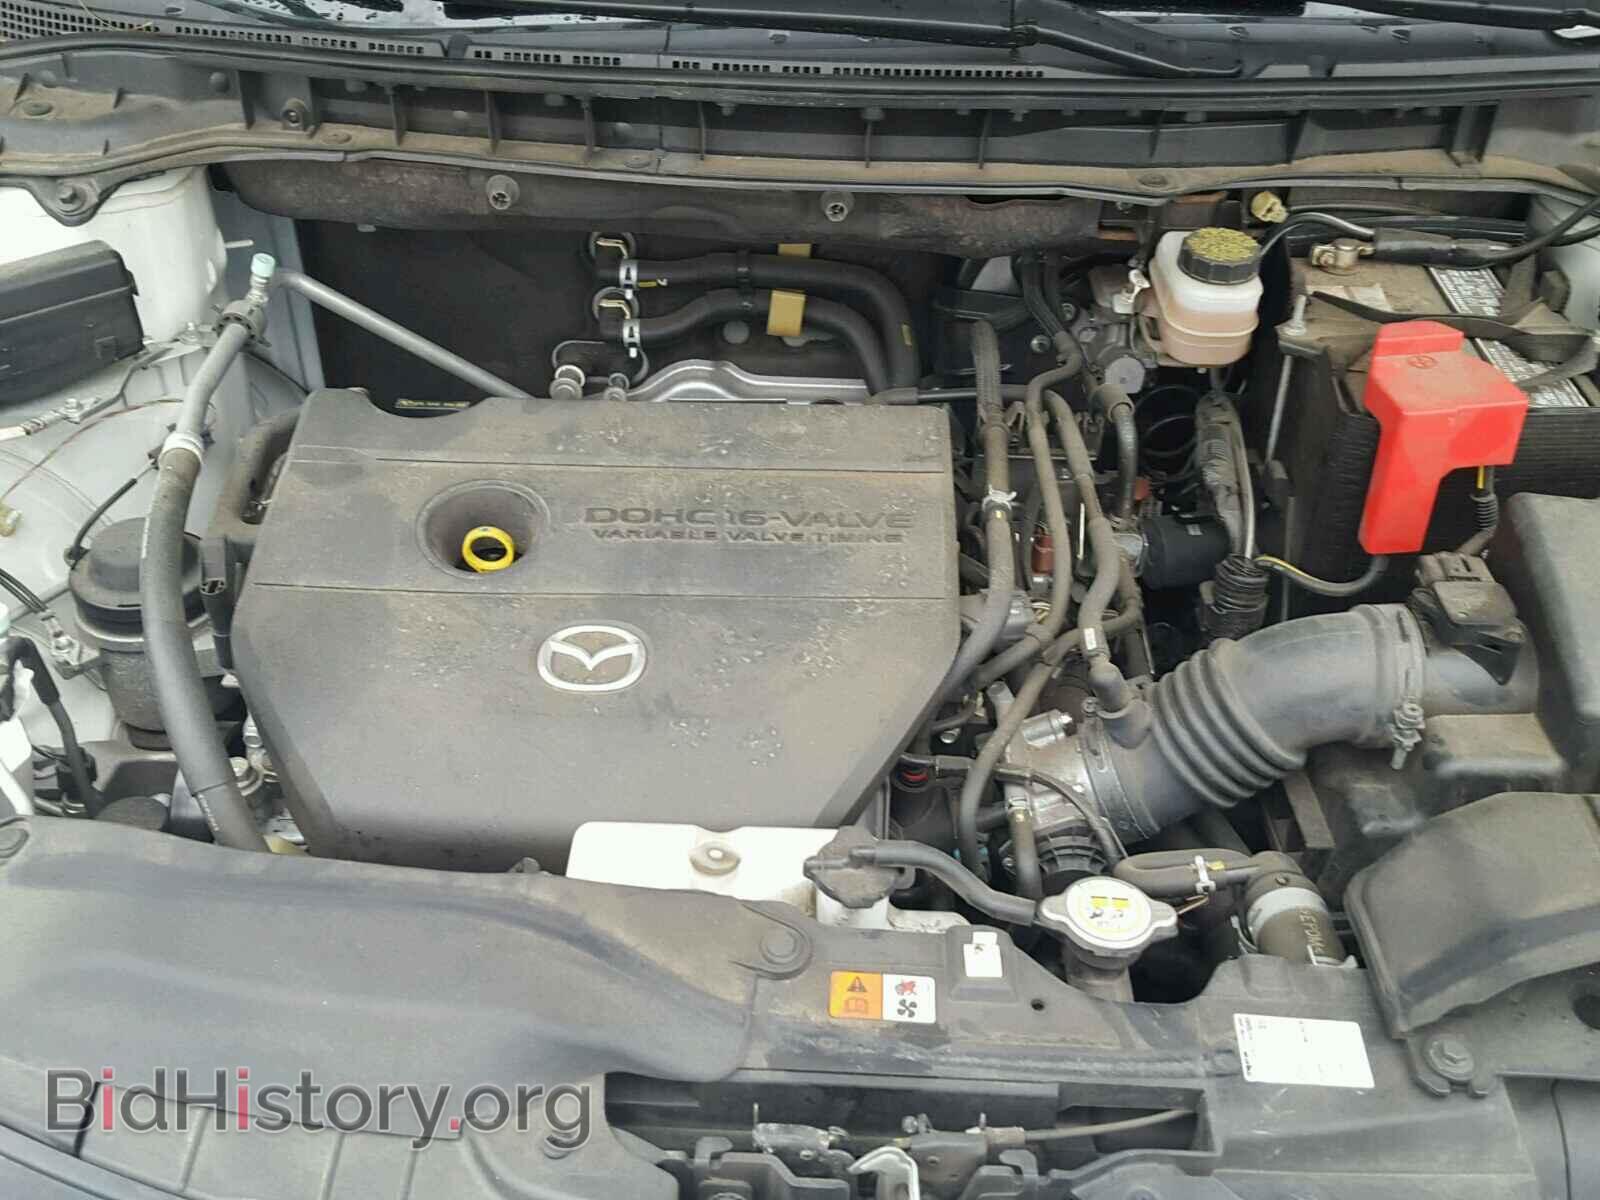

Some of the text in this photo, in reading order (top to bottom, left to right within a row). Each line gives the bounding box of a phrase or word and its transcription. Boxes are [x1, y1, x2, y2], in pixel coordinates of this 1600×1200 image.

[586, 507, 718, 527] DOHC
[593, 528, 717, 542] VARIABLE
[728, 530, 803, 543] VALVE
